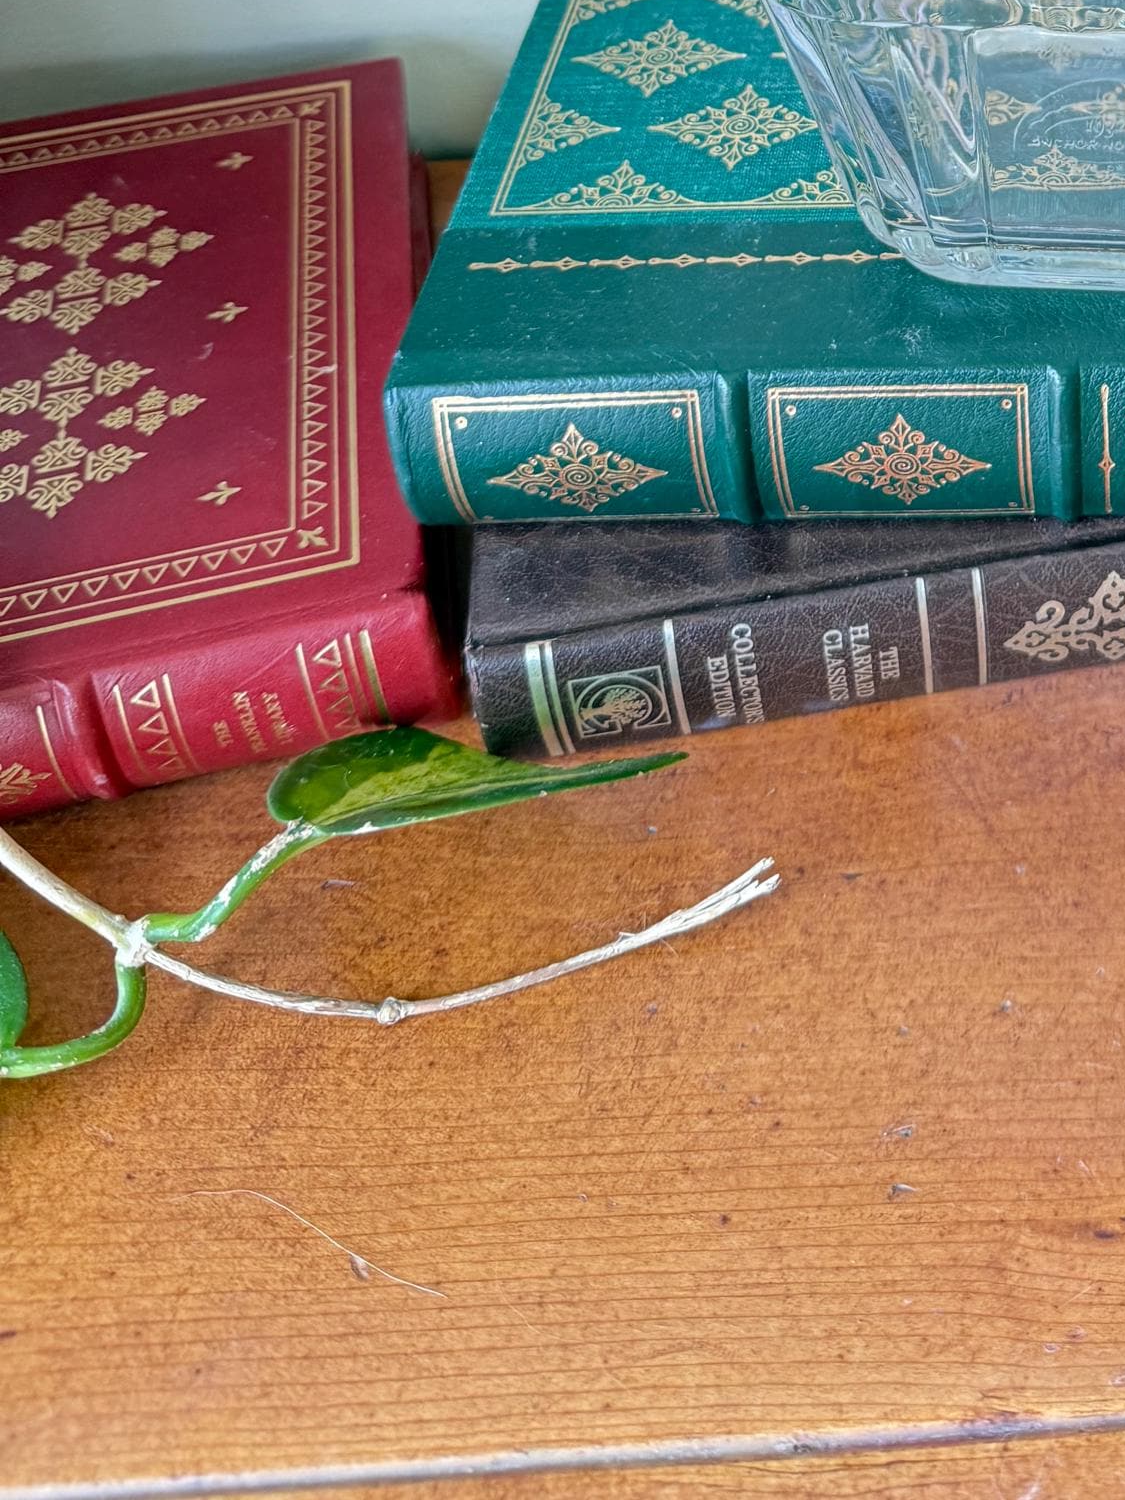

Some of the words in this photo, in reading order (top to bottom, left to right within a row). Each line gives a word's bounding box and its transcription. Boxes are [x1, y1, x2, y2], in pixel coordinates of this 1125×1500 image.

[707, 654, 737, 717] EDITION
[824, 629, 849, 701] CLASSICS
[849, 623, 875, 698] HARVARD
[879, 647, 900, 680] THE
